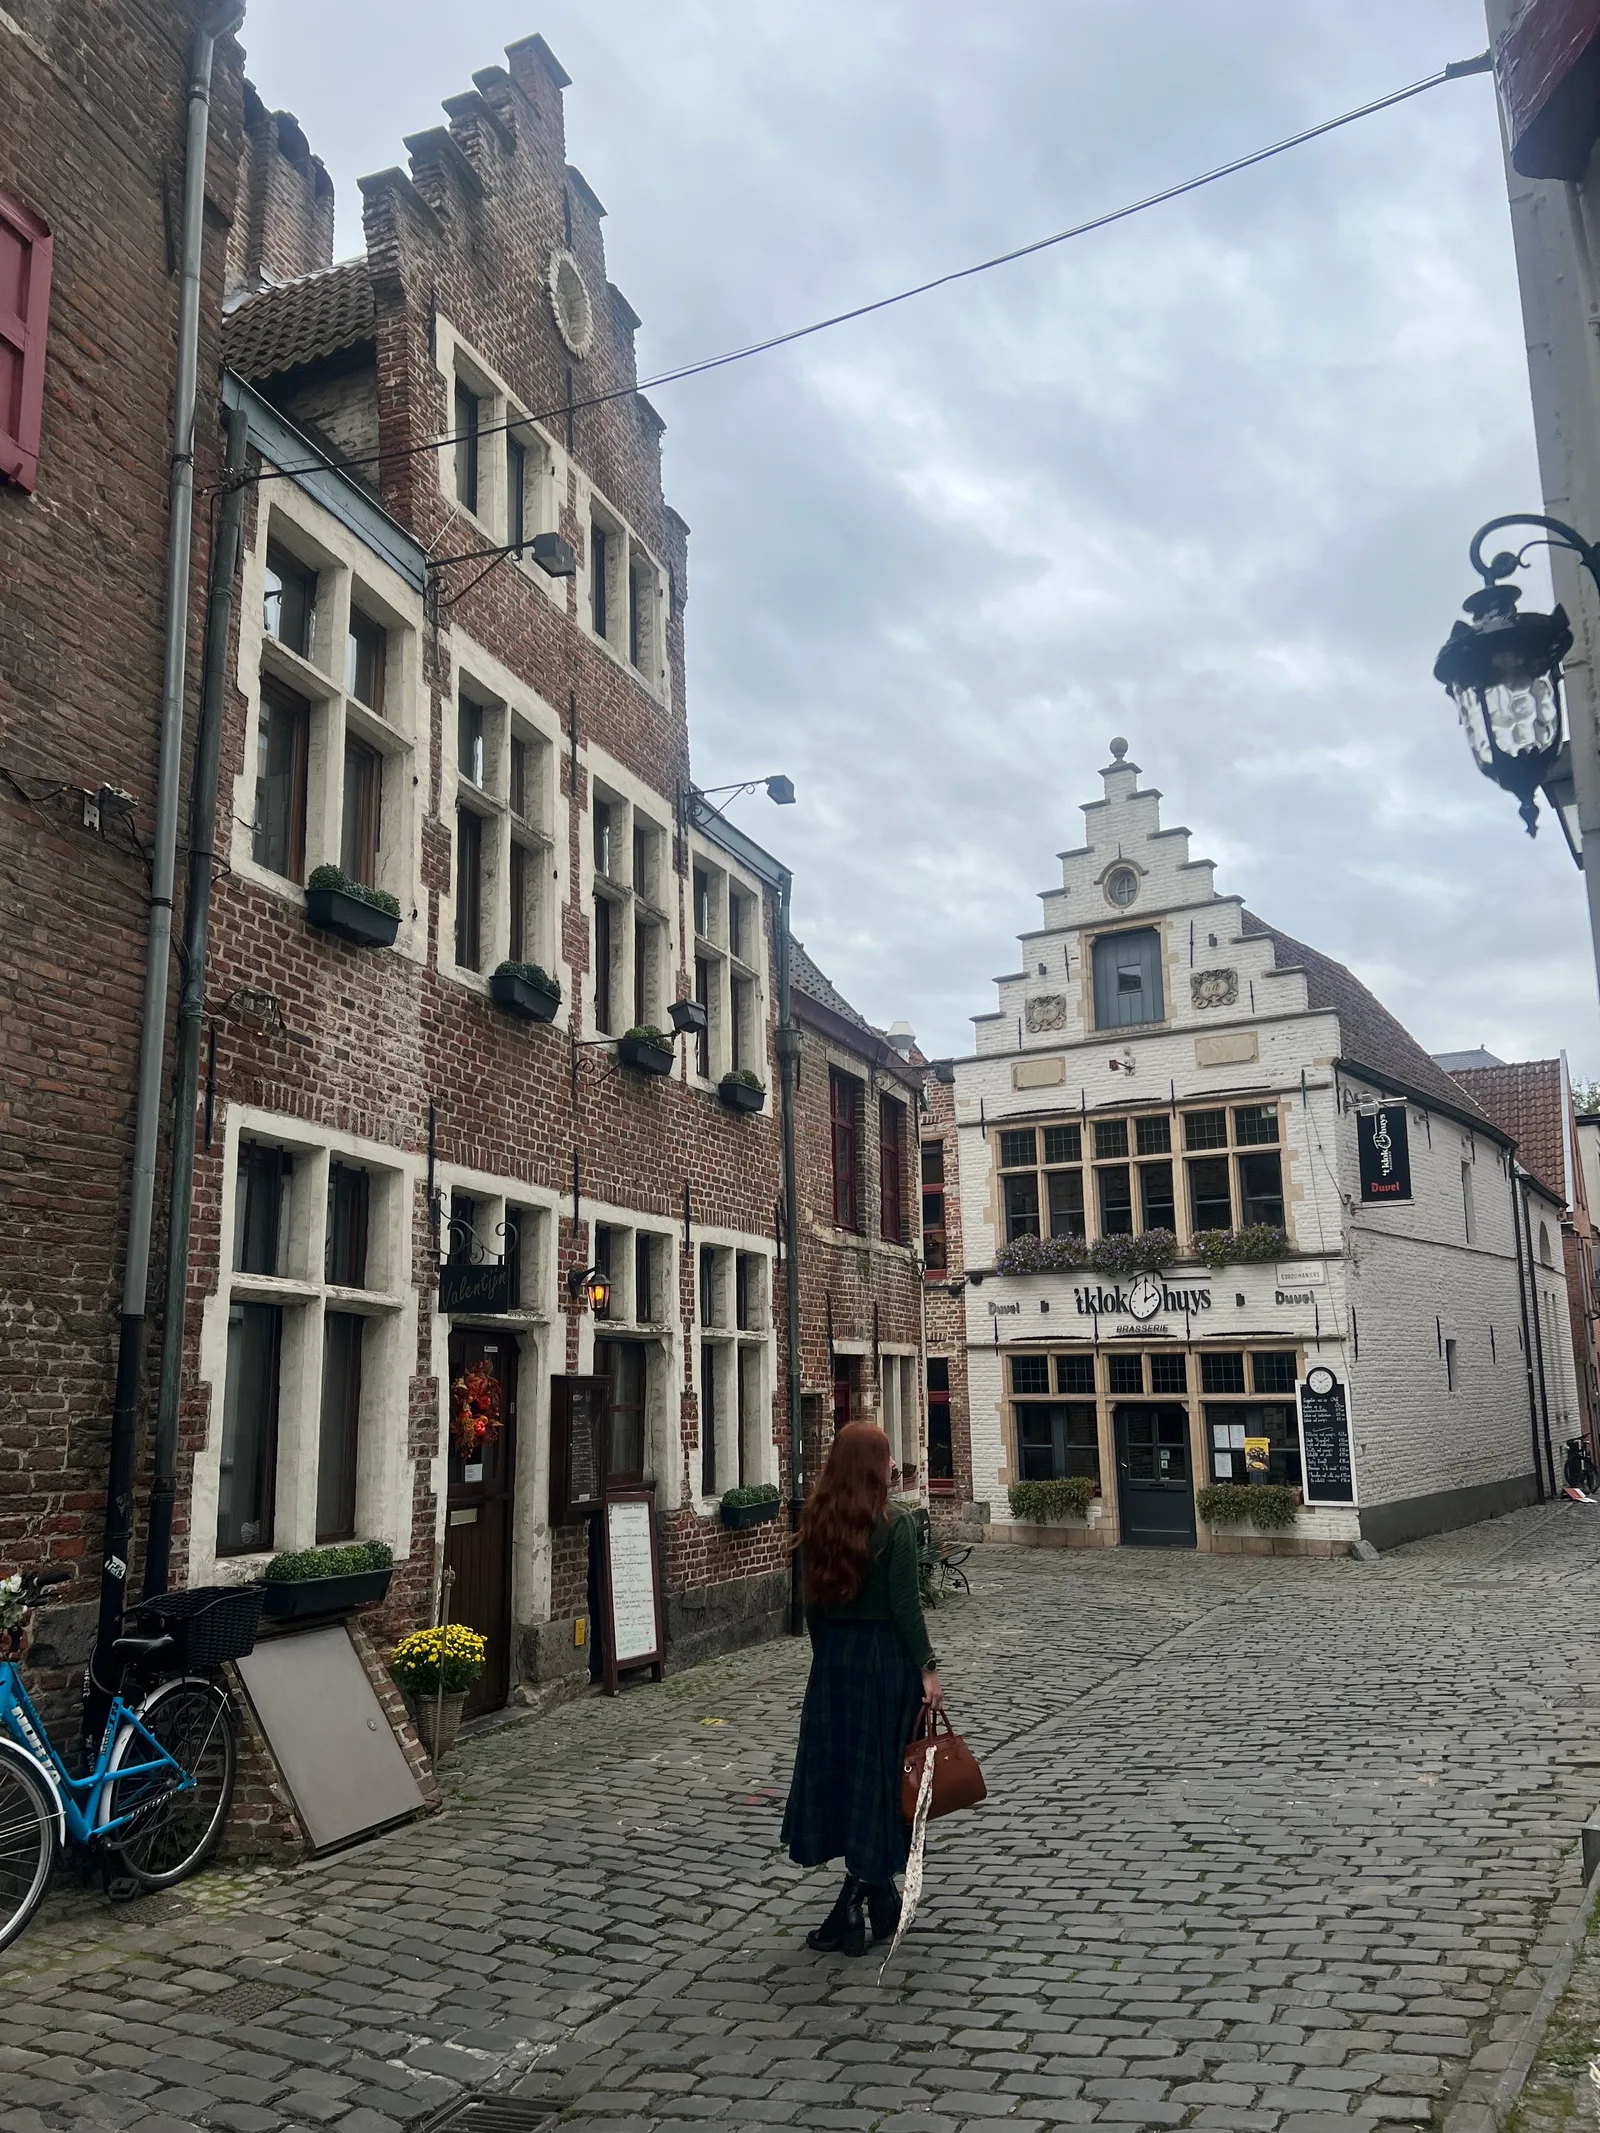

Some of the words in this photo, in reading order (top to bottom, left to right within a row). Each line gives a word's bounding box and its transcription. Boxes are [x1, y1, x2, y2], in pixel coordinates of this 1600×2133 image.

[1371, 1182, 1400, 1192] Duvel
[442, 1268, 506, 1310] Valentijn
[1275, 1290, 1315, 1305] Duvel
[988, 1301, 1020, 1315] Duvel
[1116, 1324, 1169, 1333] BRASSERIE
[11, 1706, 61, 1785] NORTA
